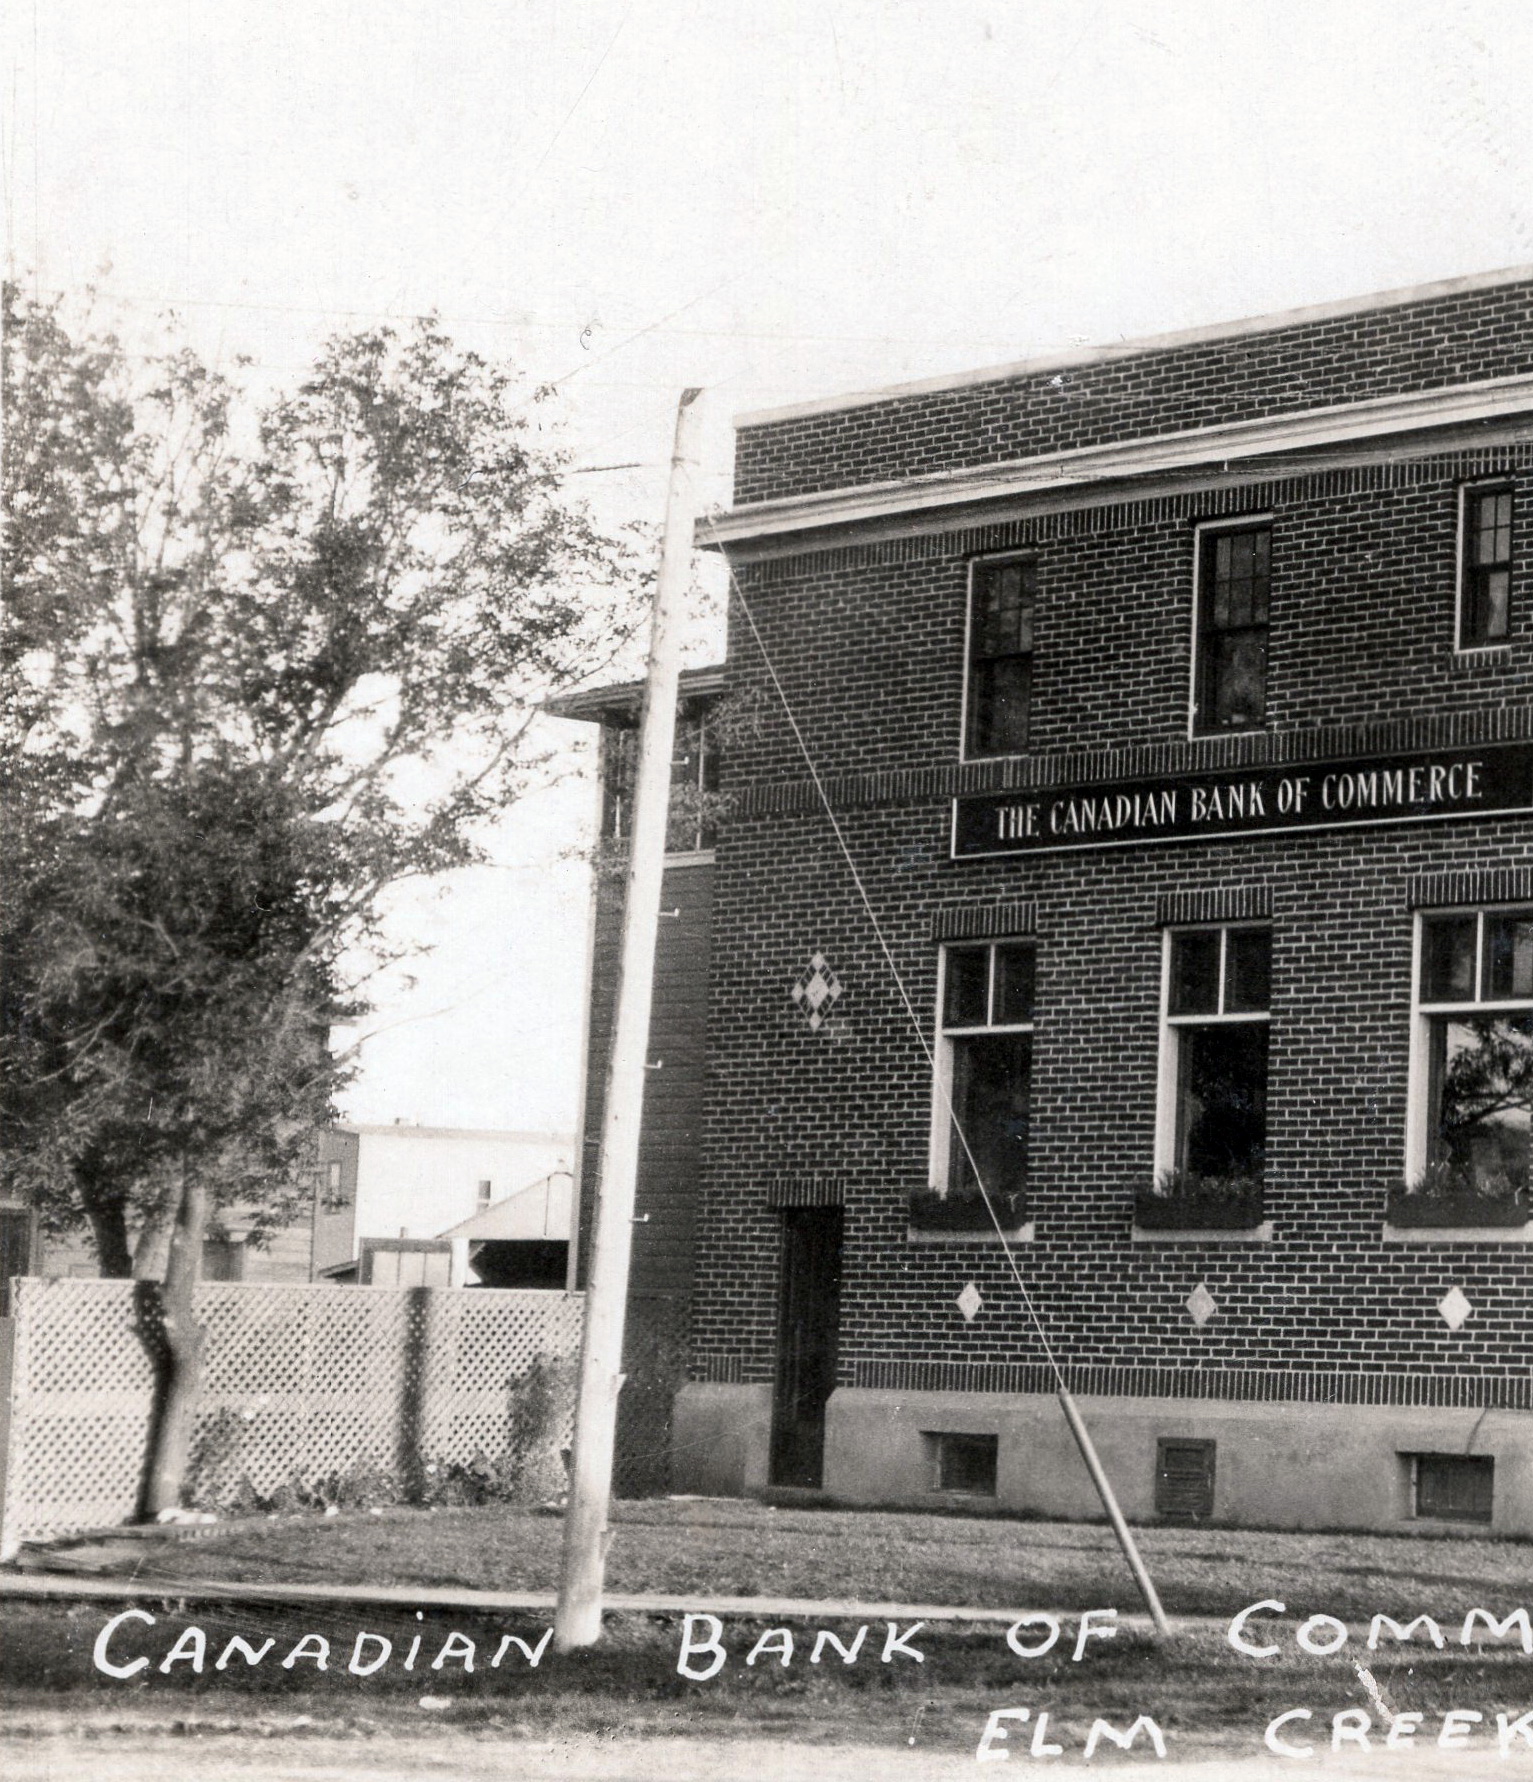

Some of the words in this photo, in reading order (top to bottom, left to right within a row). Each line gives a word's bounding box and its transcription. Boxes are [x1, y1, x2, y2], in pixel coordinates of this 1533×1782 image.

[995, 802, 1041, 840] THE
[1050, 791, 1178, 834] CANADIAN
[1190, 781, 1266, 823] BANK
[1277, 777, 1310, 815] OF
[1321, 761, 1485, 811] COMMERCE
